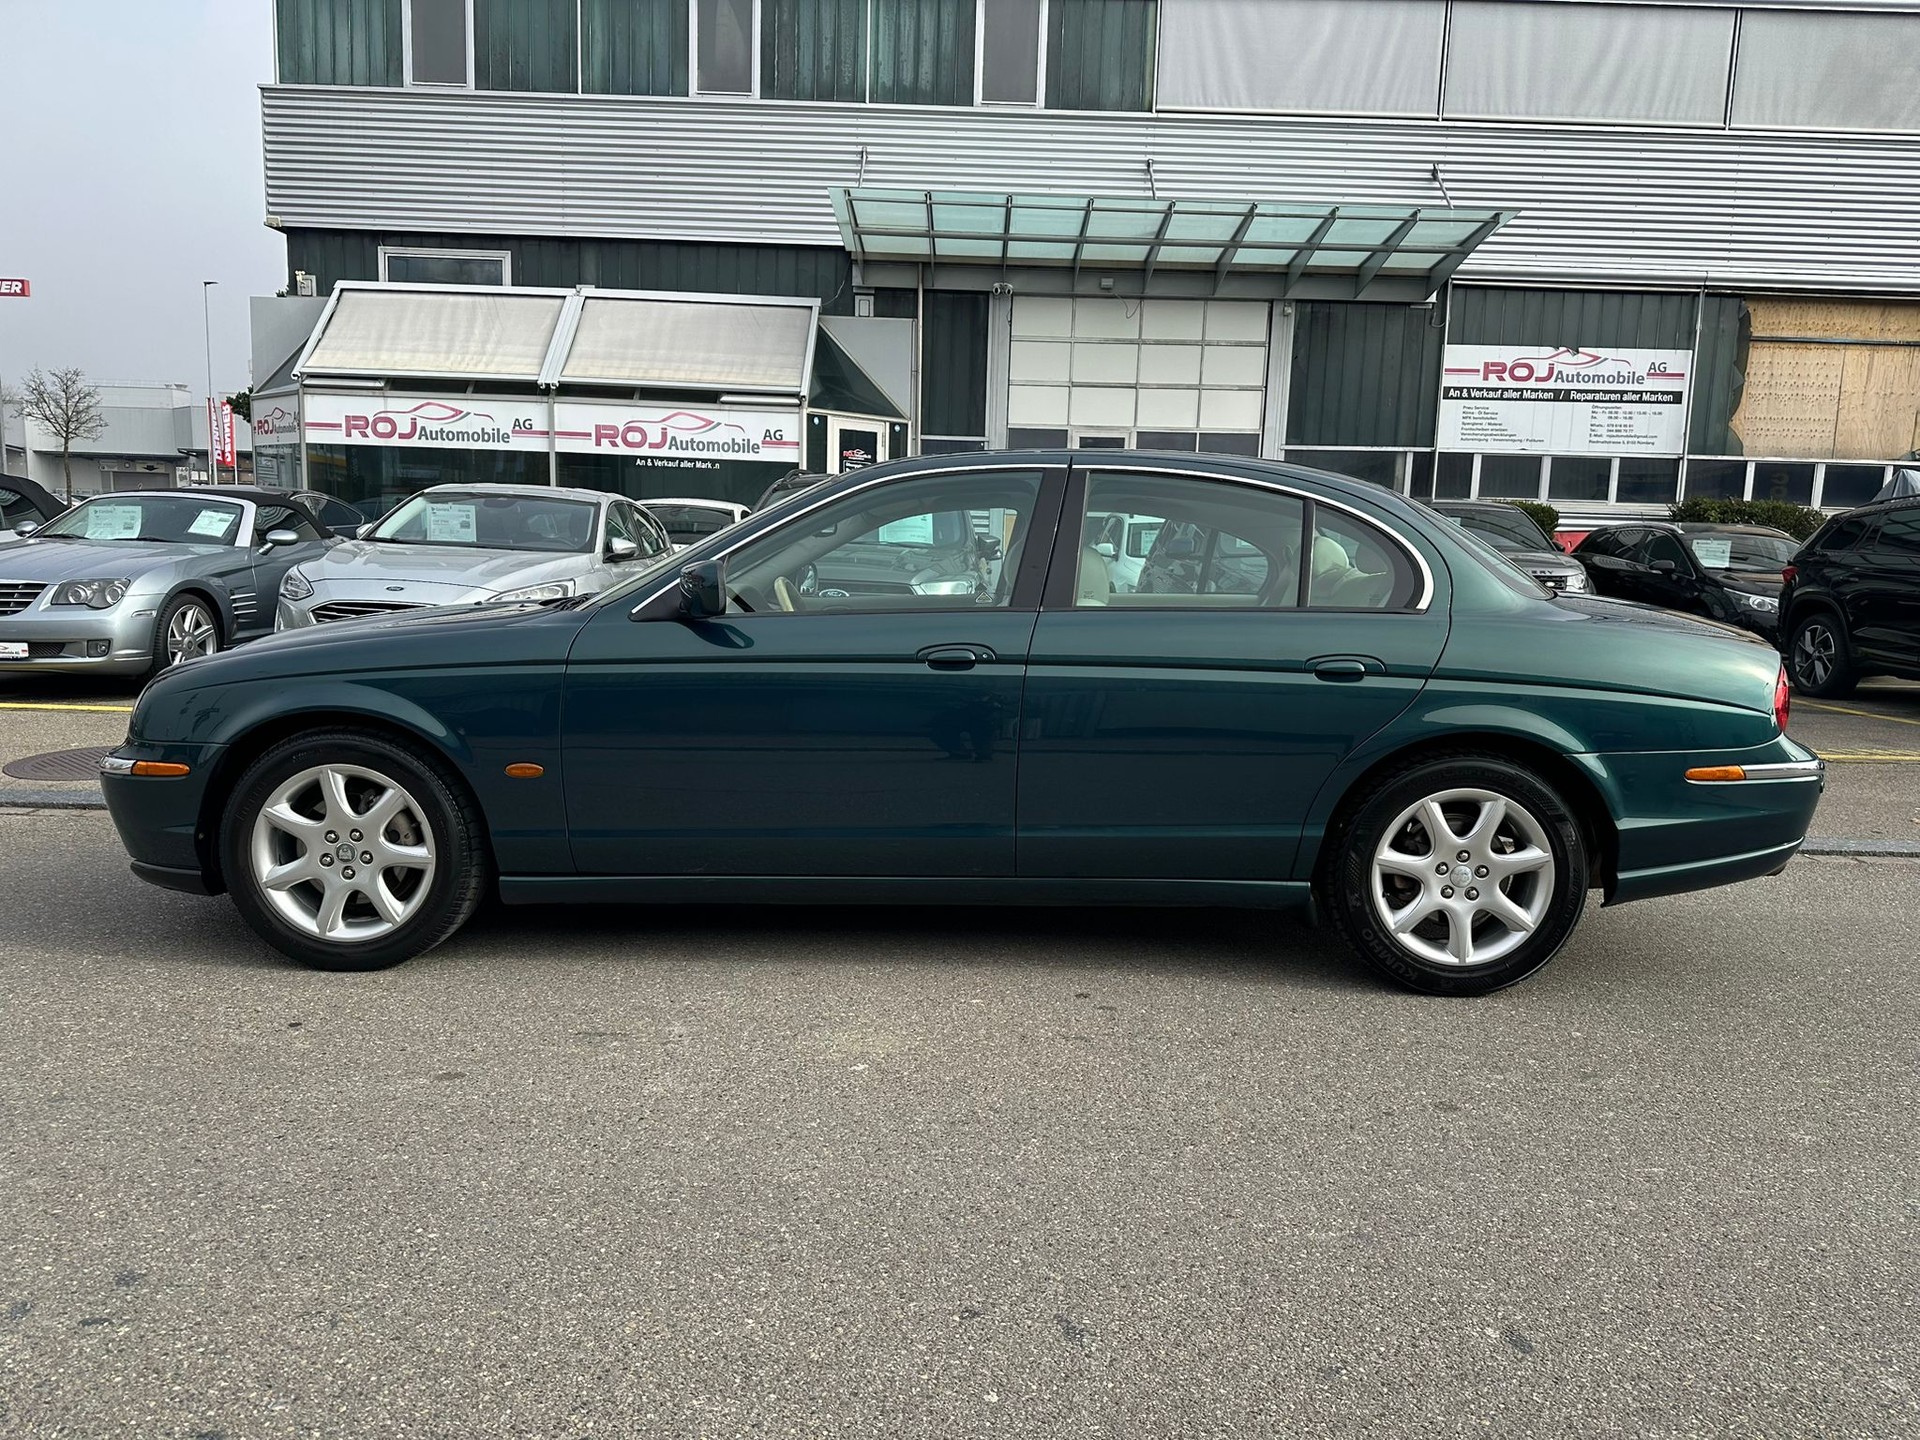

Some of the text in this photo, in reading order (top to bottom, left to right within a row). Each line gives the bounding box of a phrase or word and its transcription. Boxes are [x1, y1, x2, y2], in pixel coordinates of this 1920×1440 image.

[0, 281, 23, 293] ER
[1482, 362, 1667, 385] ROJ Automobile AG
[1448, 388, 1460, 398] An
[1462, 389, 1468, 398] &
[1470, 389, 1501, 399] Verkauf
[1503, 390, 1521, 399] aller
[1522, 390, 1554, 400] Marken
[1570, 391, 1620, 401] Reparaturen
[1622, 392, 1639, 401] aller
[1642, 392, 1673, 402] Marken
[257, 419, 275, 435] ROJ
[345, 415, 533, 444] ROJ Automobile AG
[594, 424, 784, 454] ROJ Automobile AG
[636, 458, 720, 470] An & Verkauf aller Markn
[1362, 928, 1418, 981] KUMHO
